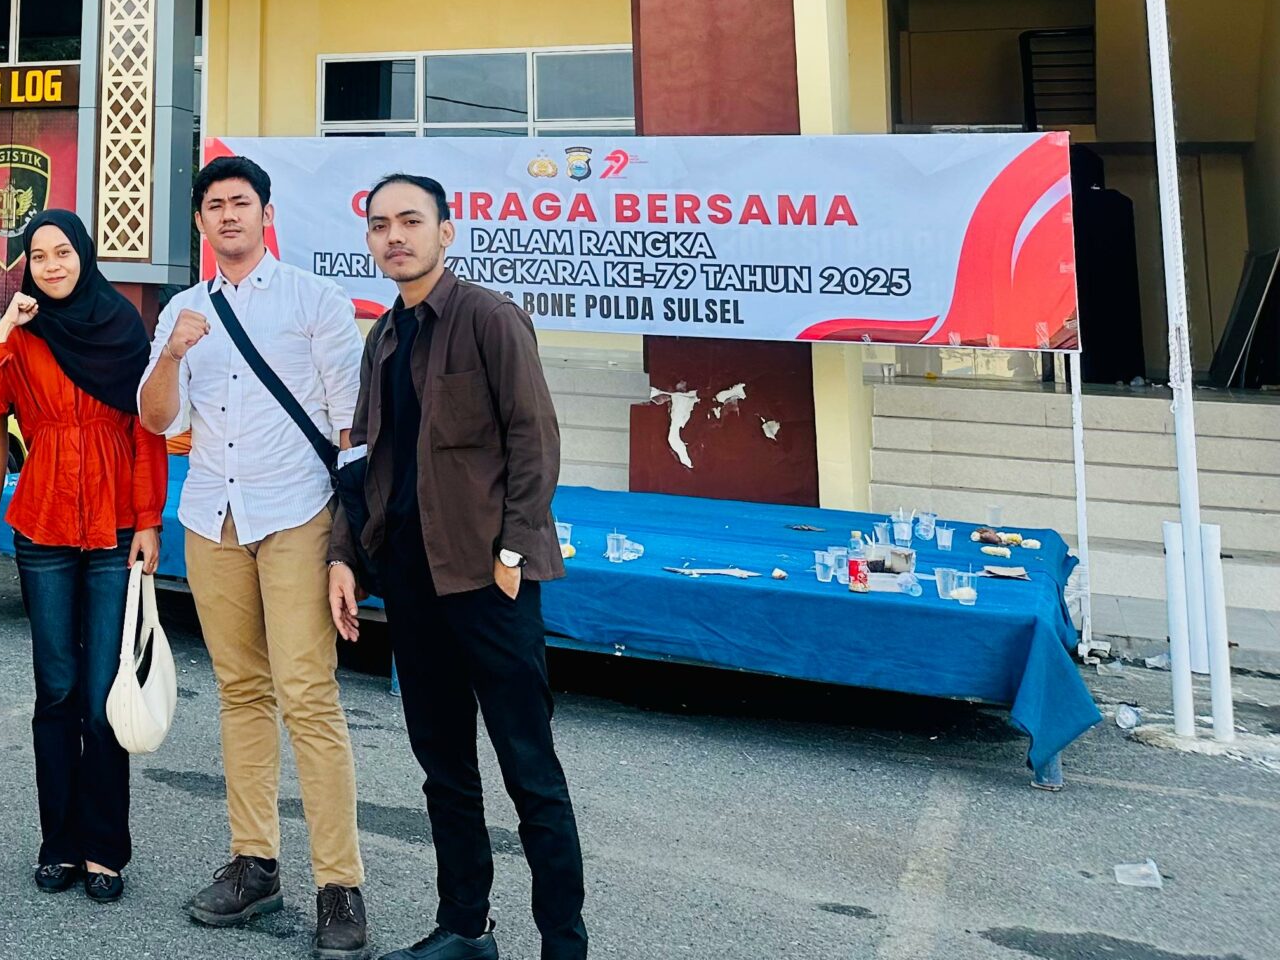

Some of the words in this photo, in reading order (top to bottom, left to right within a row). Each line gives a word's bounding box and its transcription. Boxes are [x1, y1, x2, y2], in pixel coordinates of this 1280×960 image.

[11, 69, 62, 103] LOG
[614, 193, 859, 226] BERSAMA
[471, 227, 575, 255] DALAM
[579, 230, 716, 259] RANGKA
[313, 251, 377, 279] HARI
[604, 261, 697, 290] KE-79
[700, 263, 812, 293] TAHUN
[819, 266, 911, 296] 2025
[523, 292, 576, 317] BONE
[585, 294, 654, 321] POLDA
[663, 297, 744, 324] SULSEL
